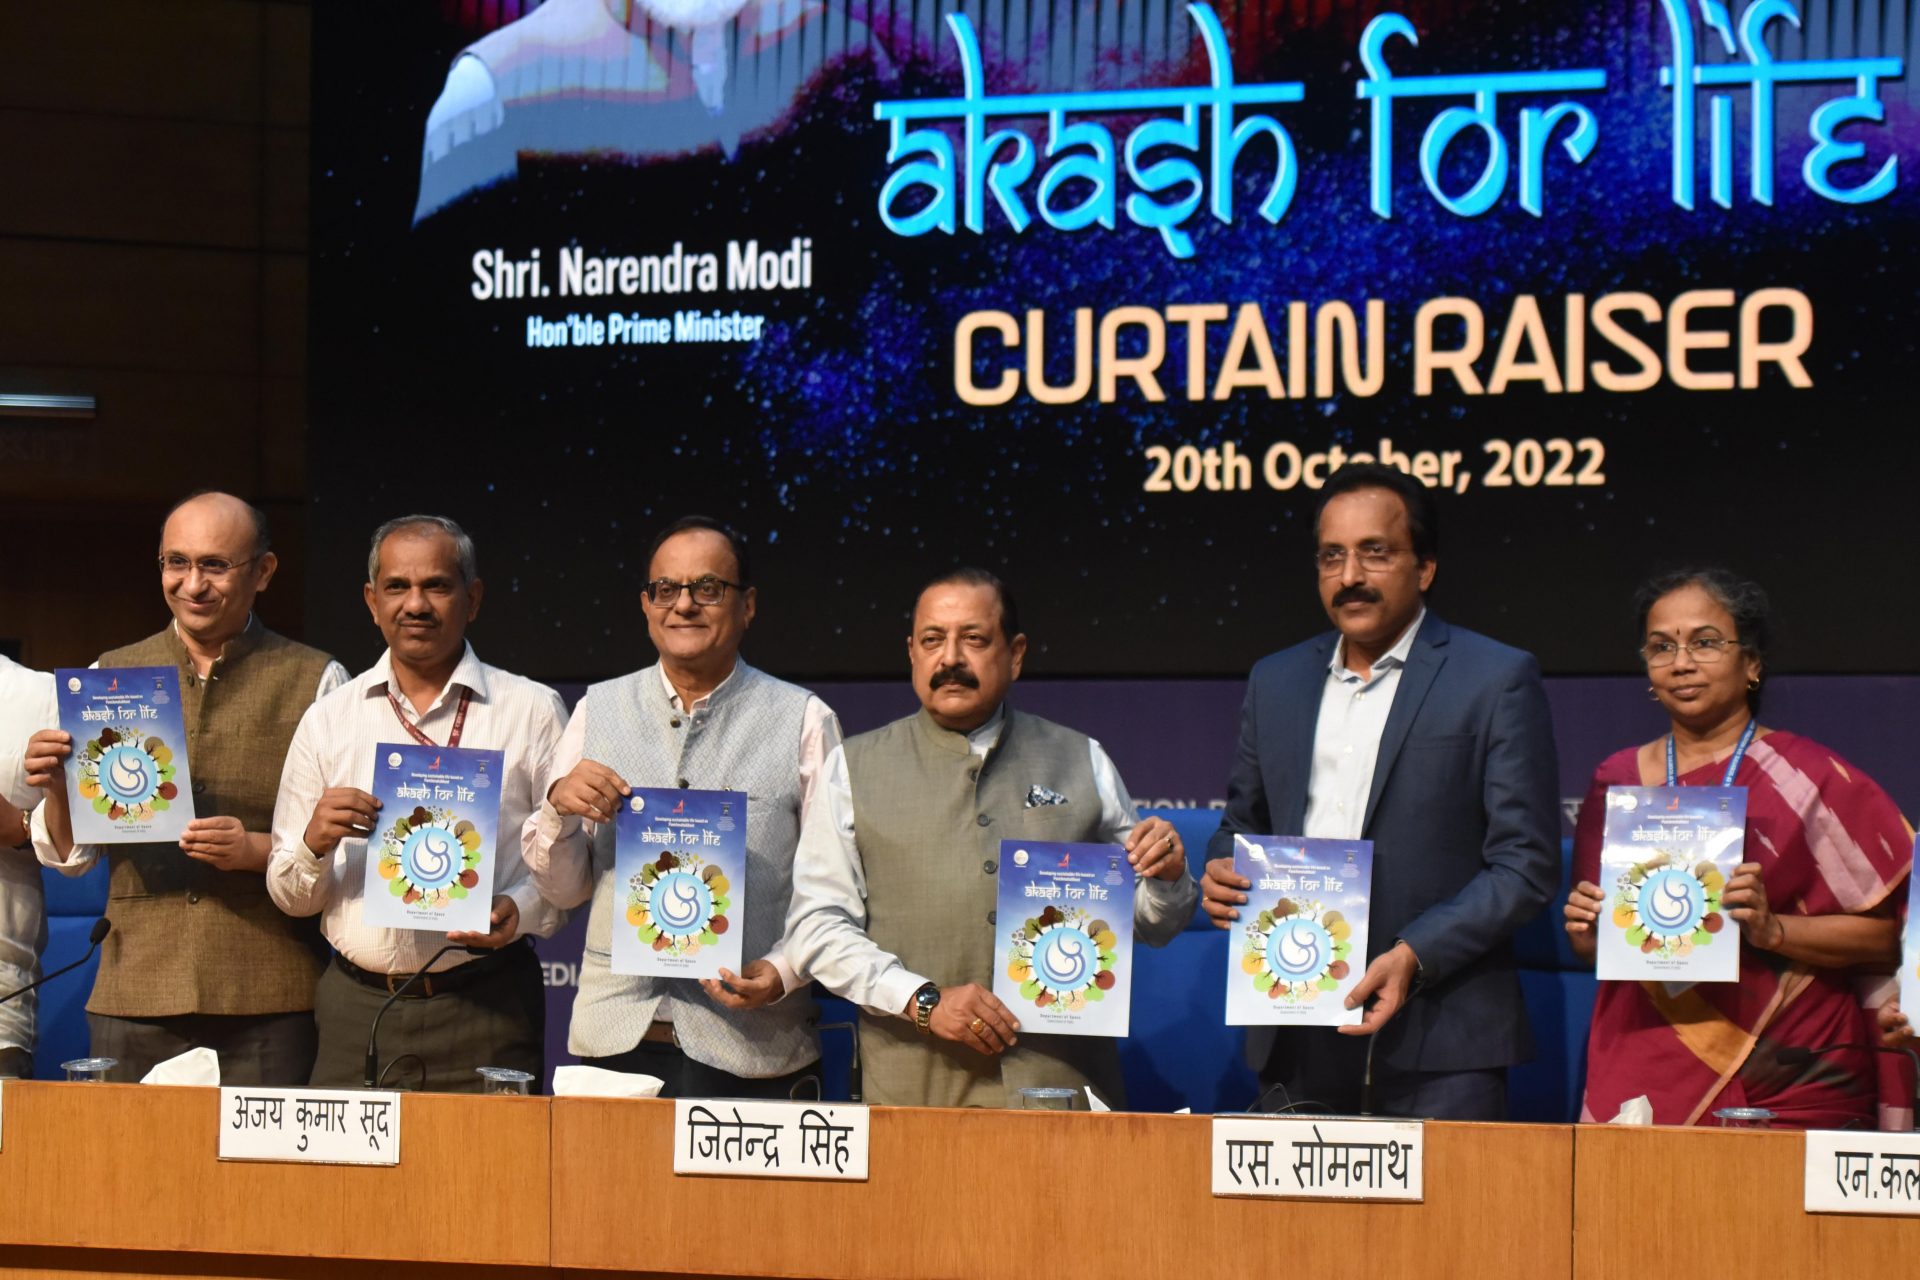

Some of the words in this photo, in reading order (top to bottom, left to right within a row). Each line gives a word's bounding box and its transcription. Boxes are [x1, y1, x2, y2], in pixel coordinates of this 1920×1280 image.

[874, 3, 1304, 258] akash
[1356, 13, 1606, 218] for
[1660, 0, 1902, 211] life
[471, 248, 550, 300] Shri.
[559, 241, 718, 296] Narendra
[726, 237, 812, 290] Modi
[526, 313, 605, 347] Hon'ble
[608, 311, 672, 345] Prime
[674, 309, 765, 342] Minister
[953, 299, 1384, 405] CURTAIN
[1413, 288, 1814, 396] RAISER
[1143, 440, 1252, 492] 20th
[1263, 438, 1471, 494] Octber,
[1482, 437, 1606, 487] 2022
[117, 706, 137, 720] for
[434, 785, 454, 801] for
[641, 826, 677, 845] akash
[680, 829, 700, 845] for
[702, 828, 721, 846] life
[1024, 880, 1061, 900] akash
[1065, 883, 1086, 900] for
[1088, 882, 1109, 901] life
[1300, 875, 1321, 892] for
[540, 961, 579, 987] EDI
[232, 1095, 286, 1130] अजय
[295, 1098, 350, 1152] कुमार
[359, 1100, 392, 1151] सूद
[687, 1105, 784, 1168] जितेन्द्र
[798, 1109, 854, 1174] सिंह
[1226, 1139, 1280, 1188] एस.
[1291, 1124, 1413, 1190] सोमनाथ
